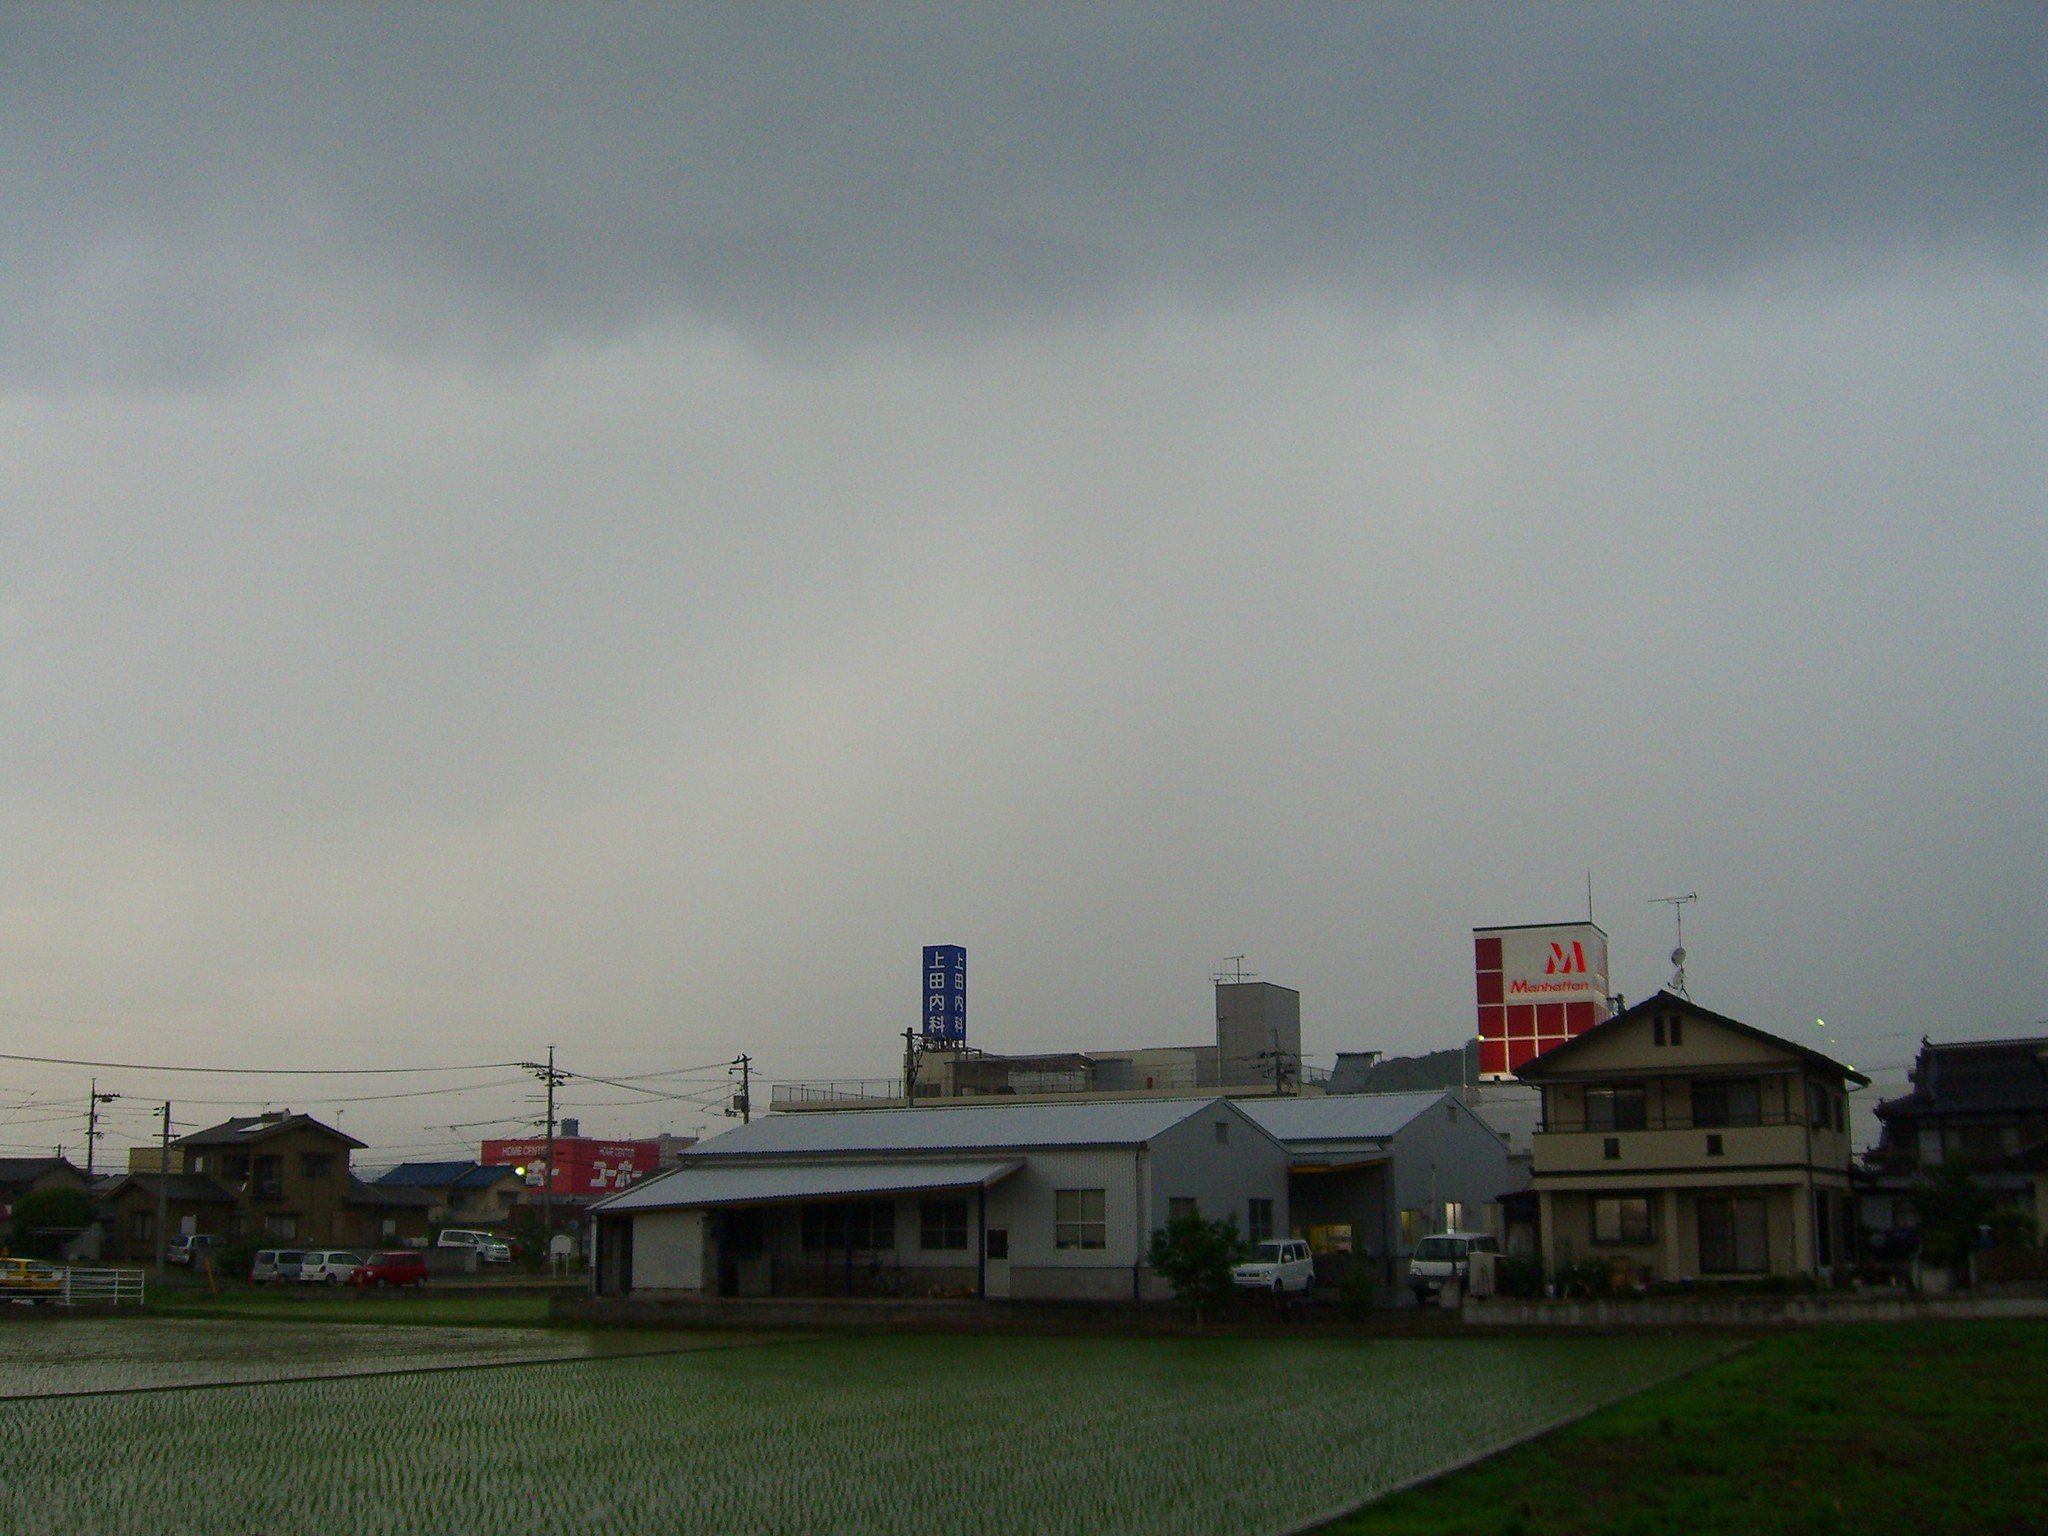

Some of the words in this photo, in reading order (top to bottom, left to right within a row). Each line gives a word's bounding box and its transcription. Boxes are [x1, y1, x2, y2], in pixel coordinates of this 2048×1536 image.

[929, 951, 945, 1033] 上田内科
[954, 952, 963, 1033] 上田内科
[1510, 979, 1589, 994] Manhattan
[502, 1146, 523, 1157] HOME
[598, 1146, 614, 1157] HOME
